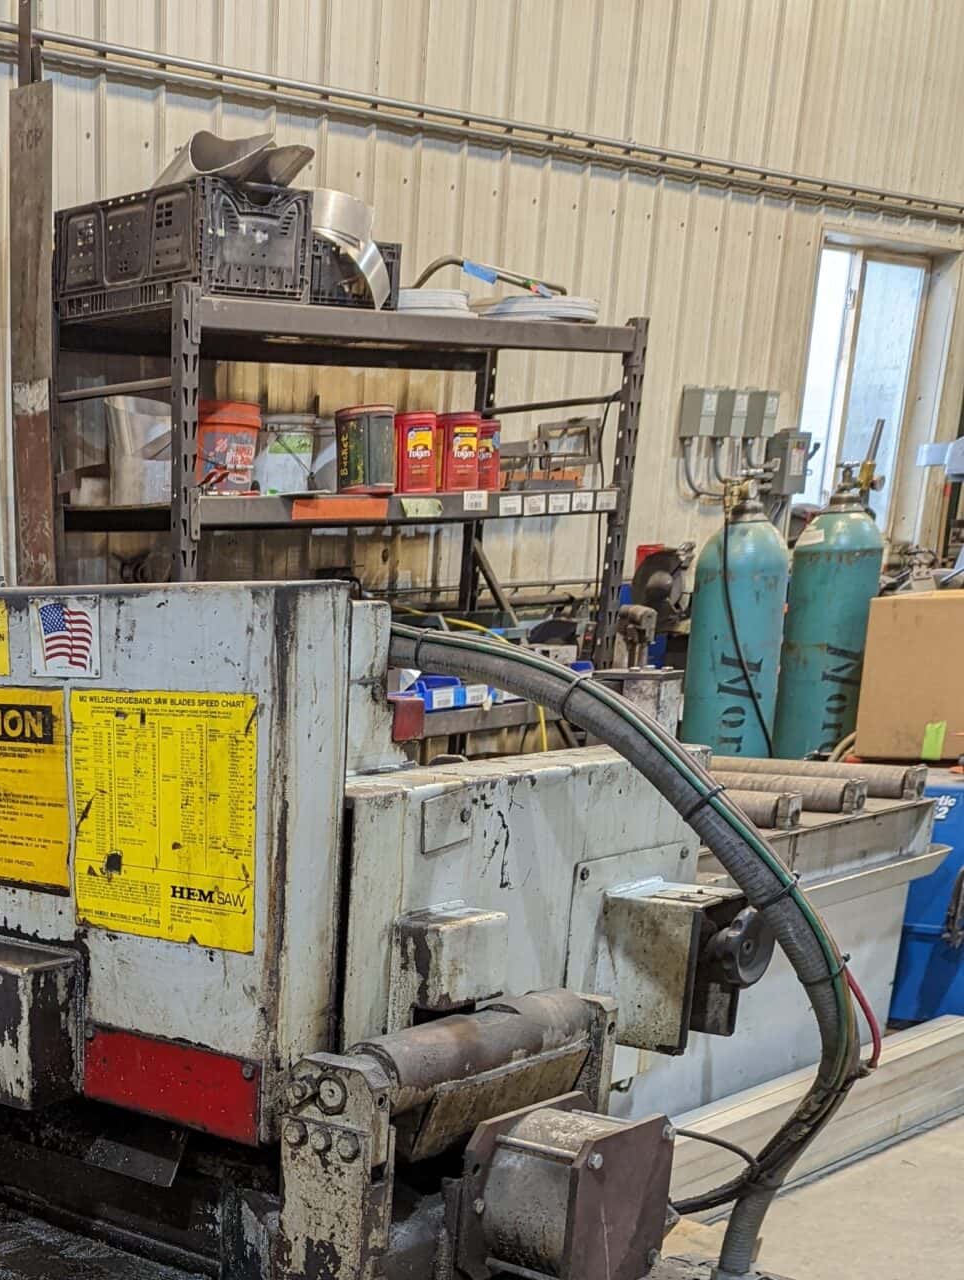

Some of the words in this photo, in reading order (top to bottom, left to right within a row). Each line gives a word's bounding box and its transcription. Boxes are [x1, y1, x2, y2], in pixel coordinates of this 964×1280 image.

[408, 447, 431, 460] Folgers
[453, 448, 476, 460] Folgers
[153, 697, 168, 706] SAW
[170, 698, 195, 707] BLADES
[197, 699, 220, 708] SPEED
[221, 700, 245, 709] CHART
[170, 885, 215, 904] HEM
[216, 890, 246, 908] SAW
